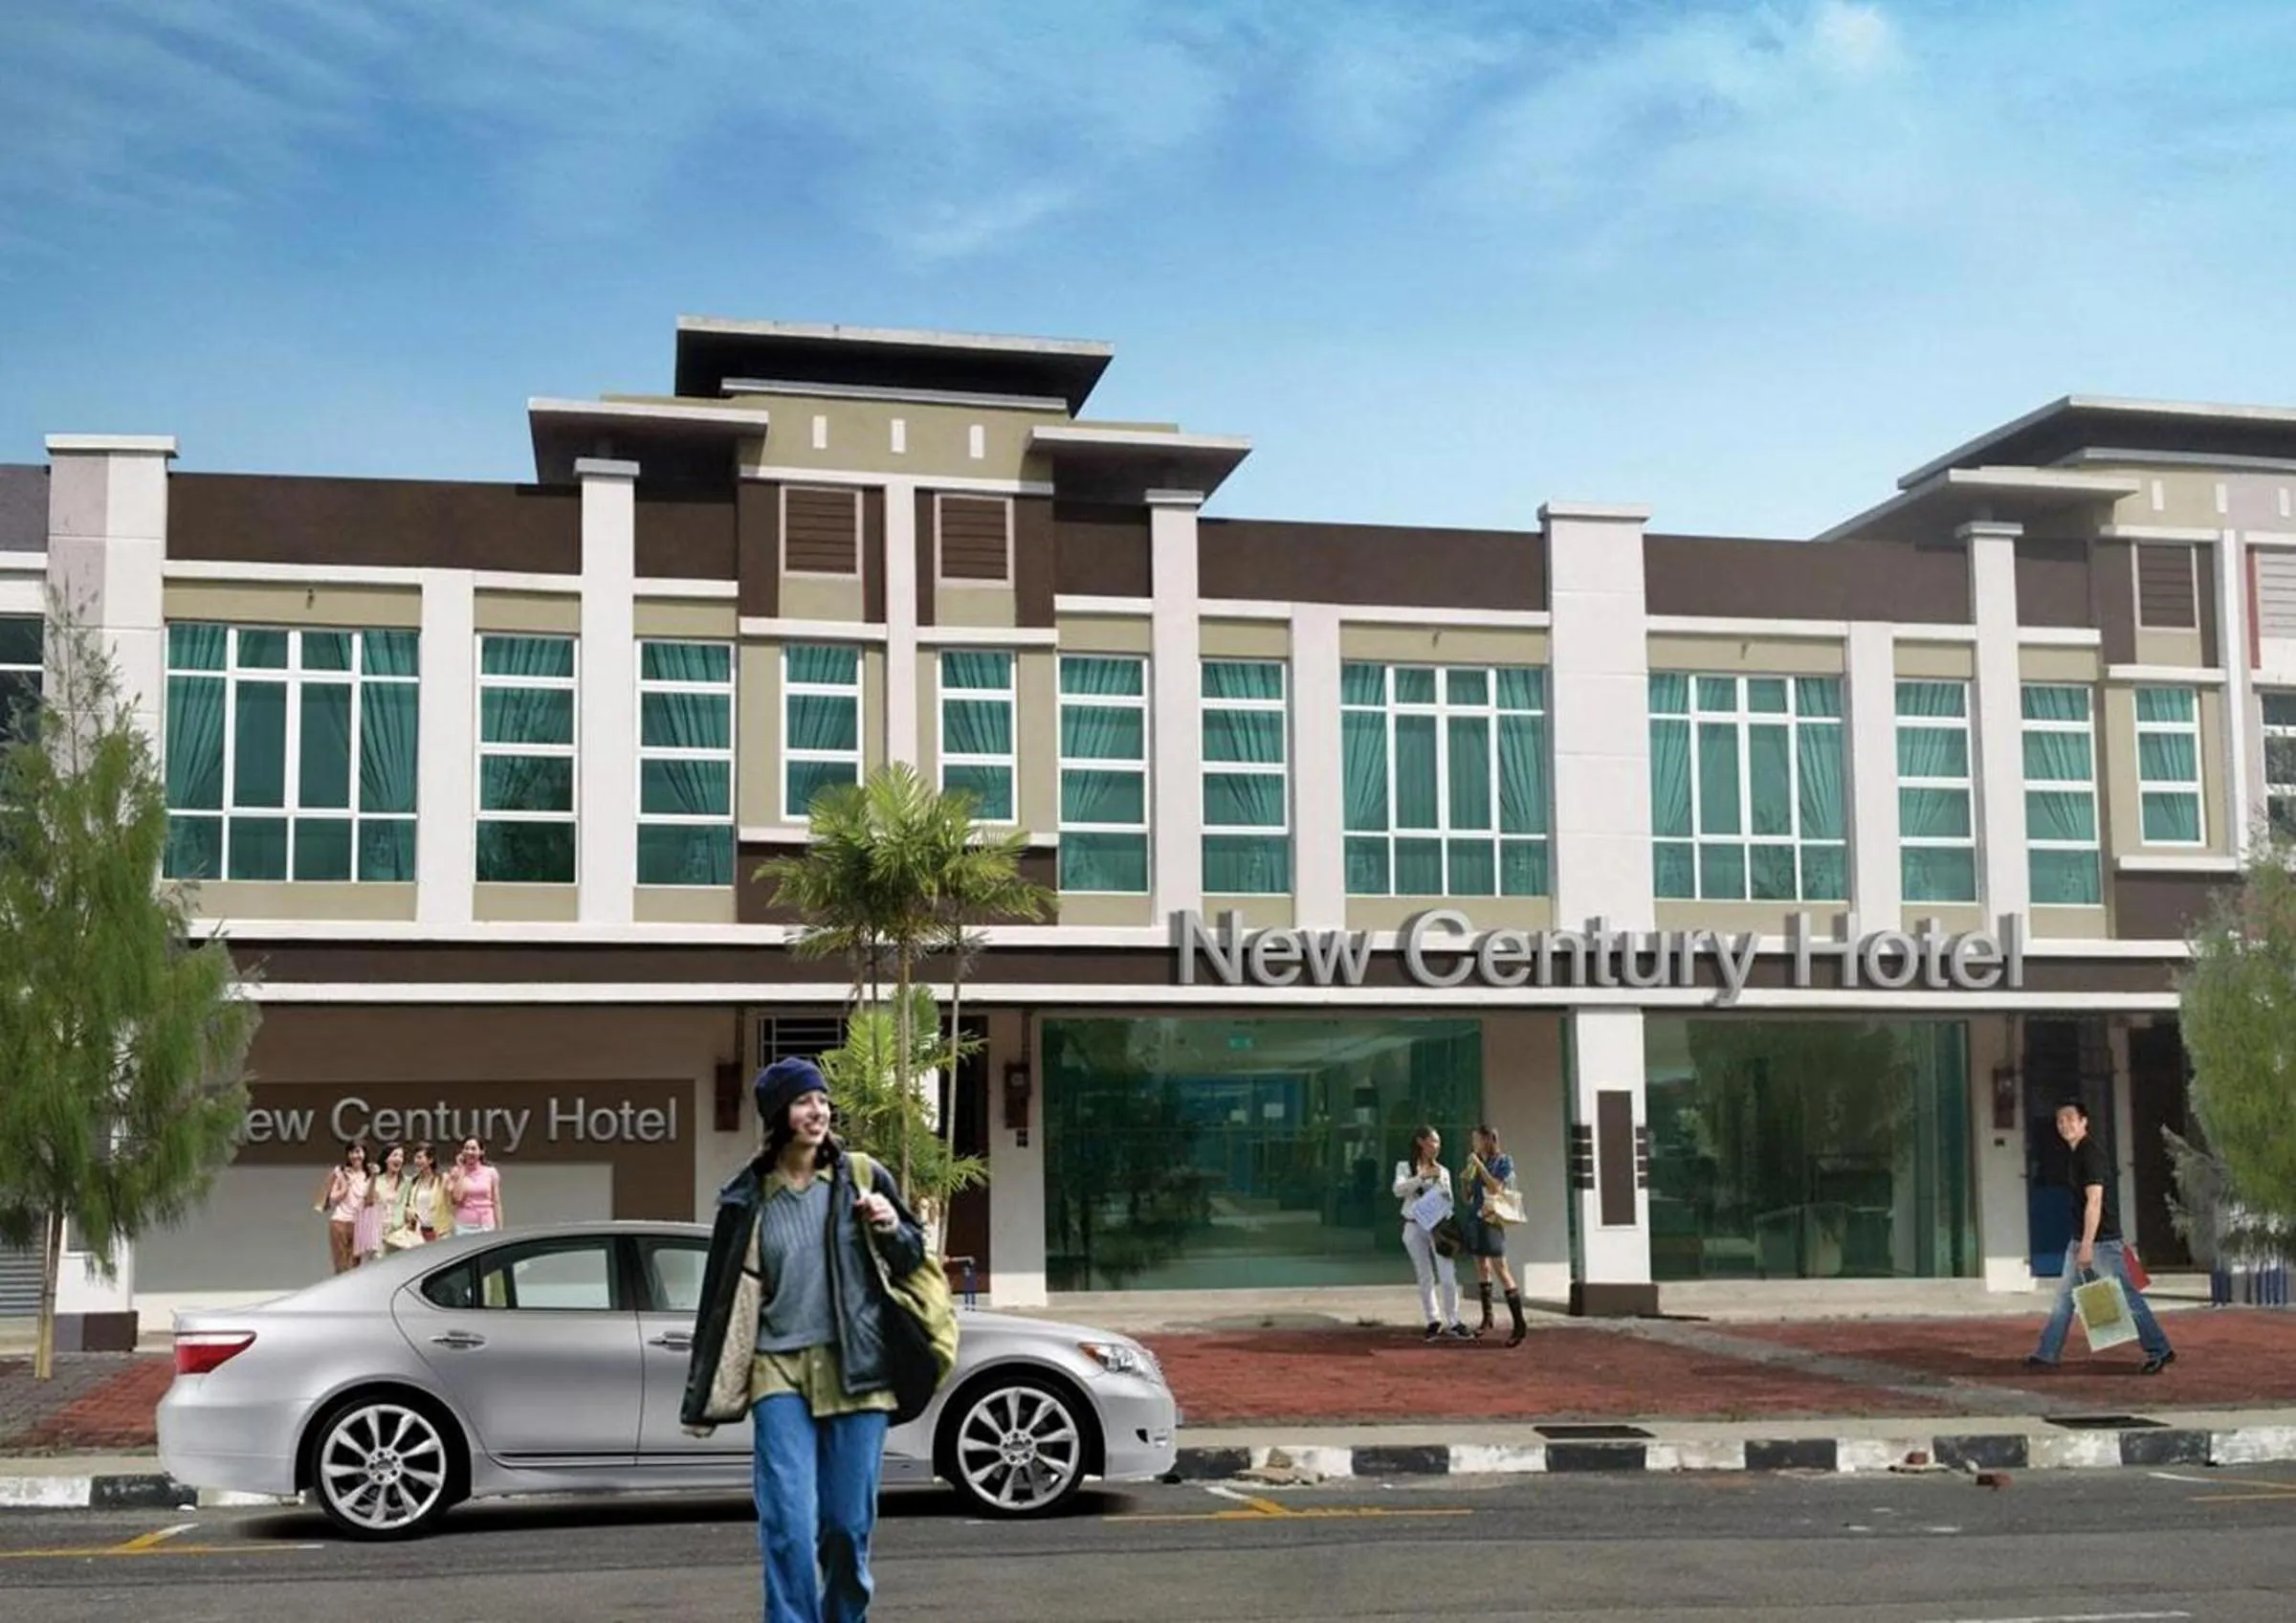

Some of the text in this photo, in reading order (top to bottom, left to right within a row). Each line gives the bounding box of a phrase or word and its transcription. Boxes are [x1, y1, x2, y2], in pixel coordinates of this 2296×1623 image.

[1170, 908, 2024, 1008] New Century Hotel
[232, 1096, 677, 1152] ew Century Hotel
